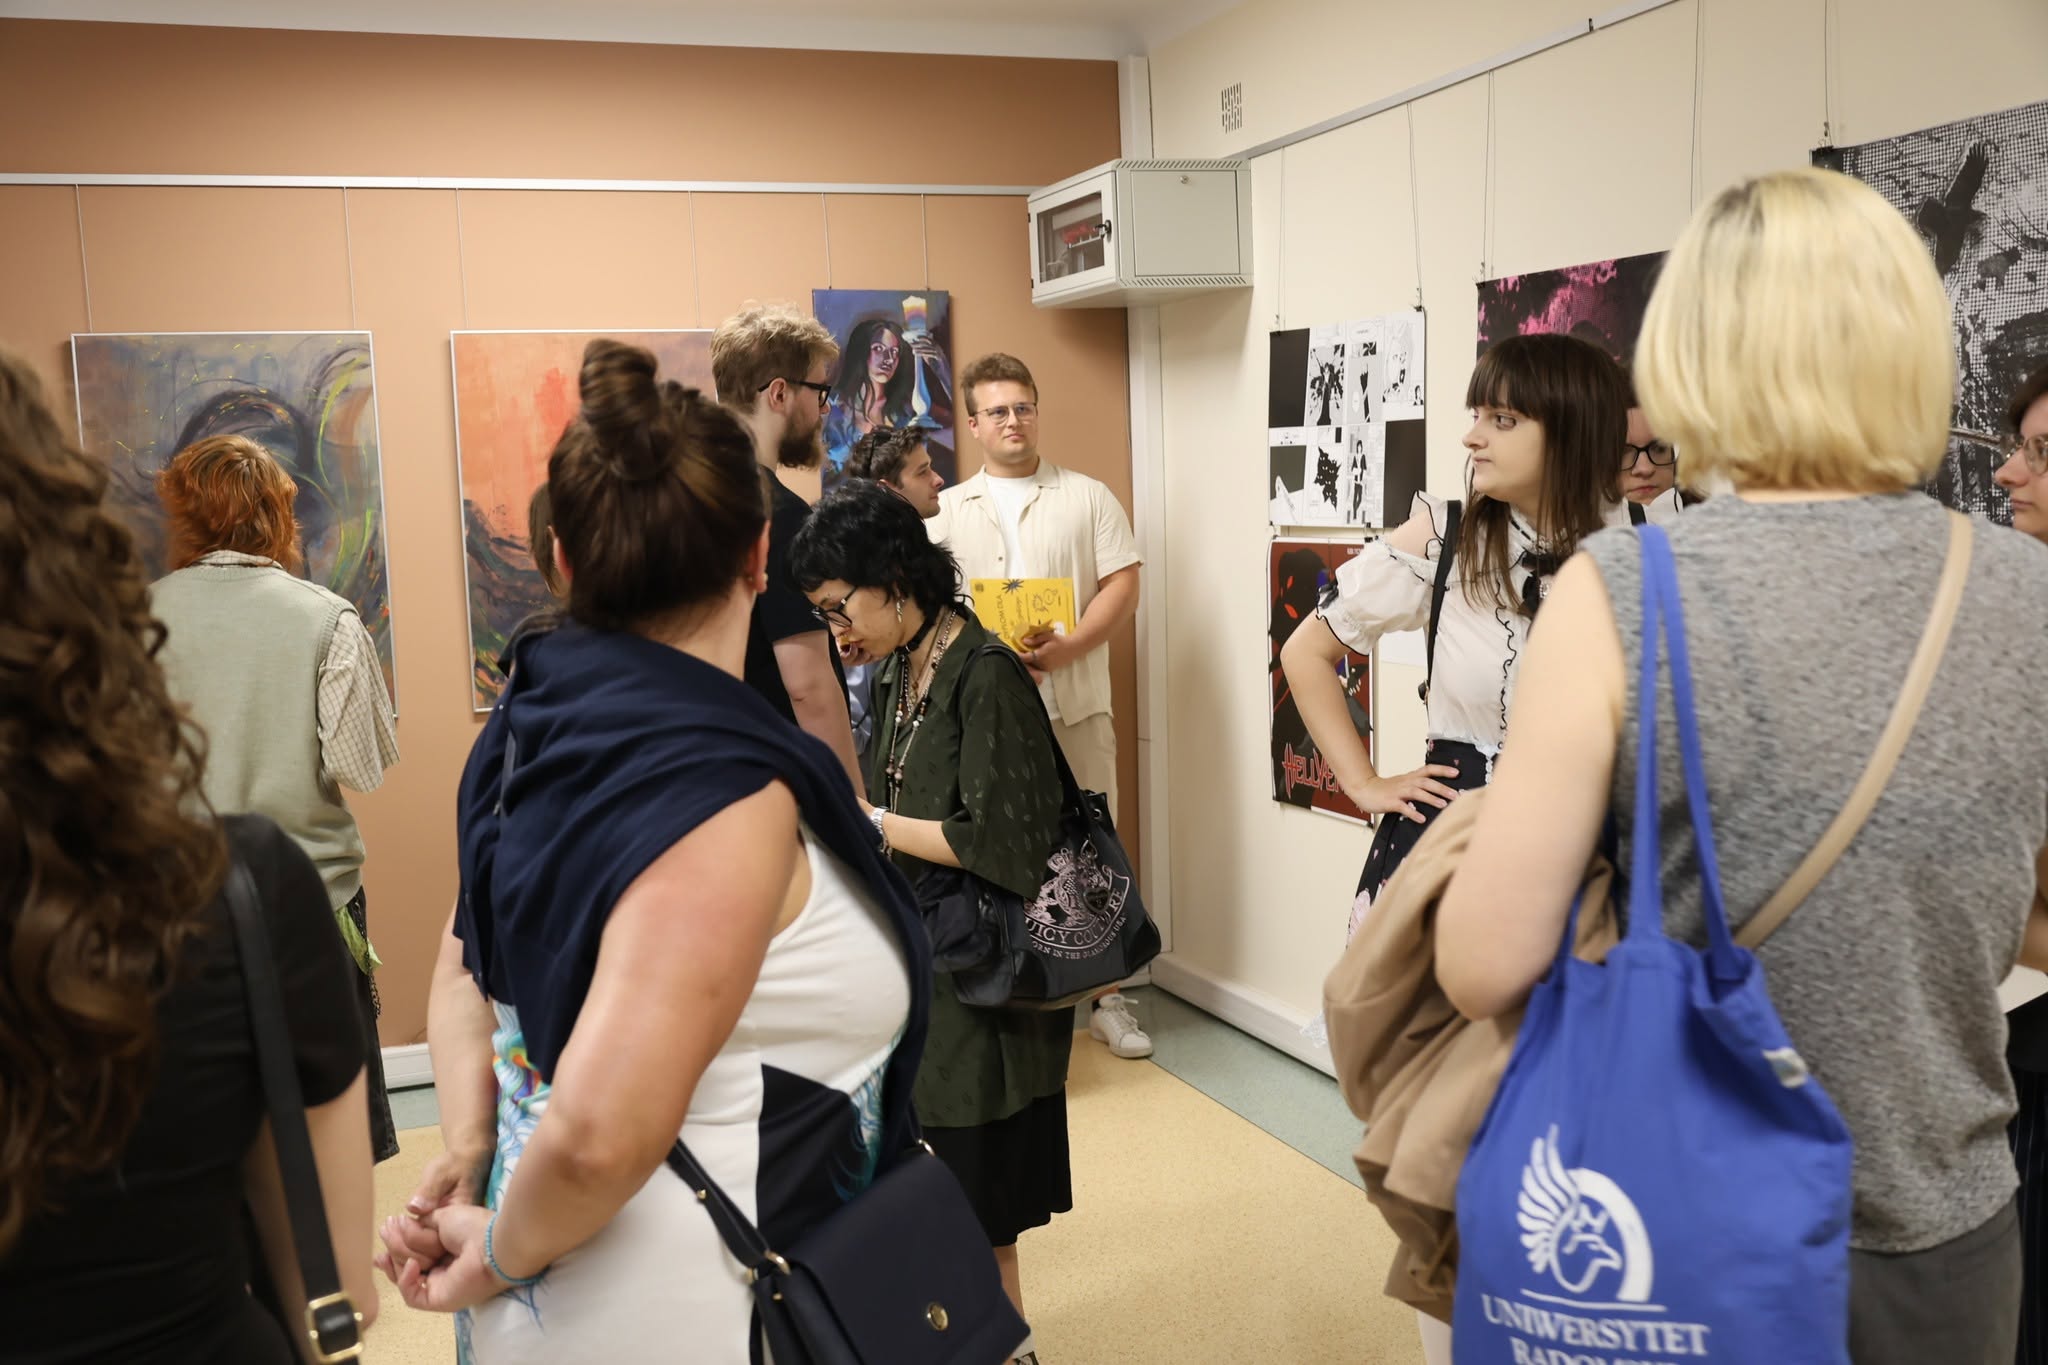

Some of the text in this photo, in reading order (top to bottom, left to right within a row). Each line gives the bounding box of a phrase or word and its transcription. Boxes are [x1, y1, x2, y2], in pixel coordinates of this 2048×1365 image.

[996, 594, 1005, 609] DLA
[1025, 917, 1071, 945] UICY
[1481, 1293, 1711, 1356] UNIWERSYTET
